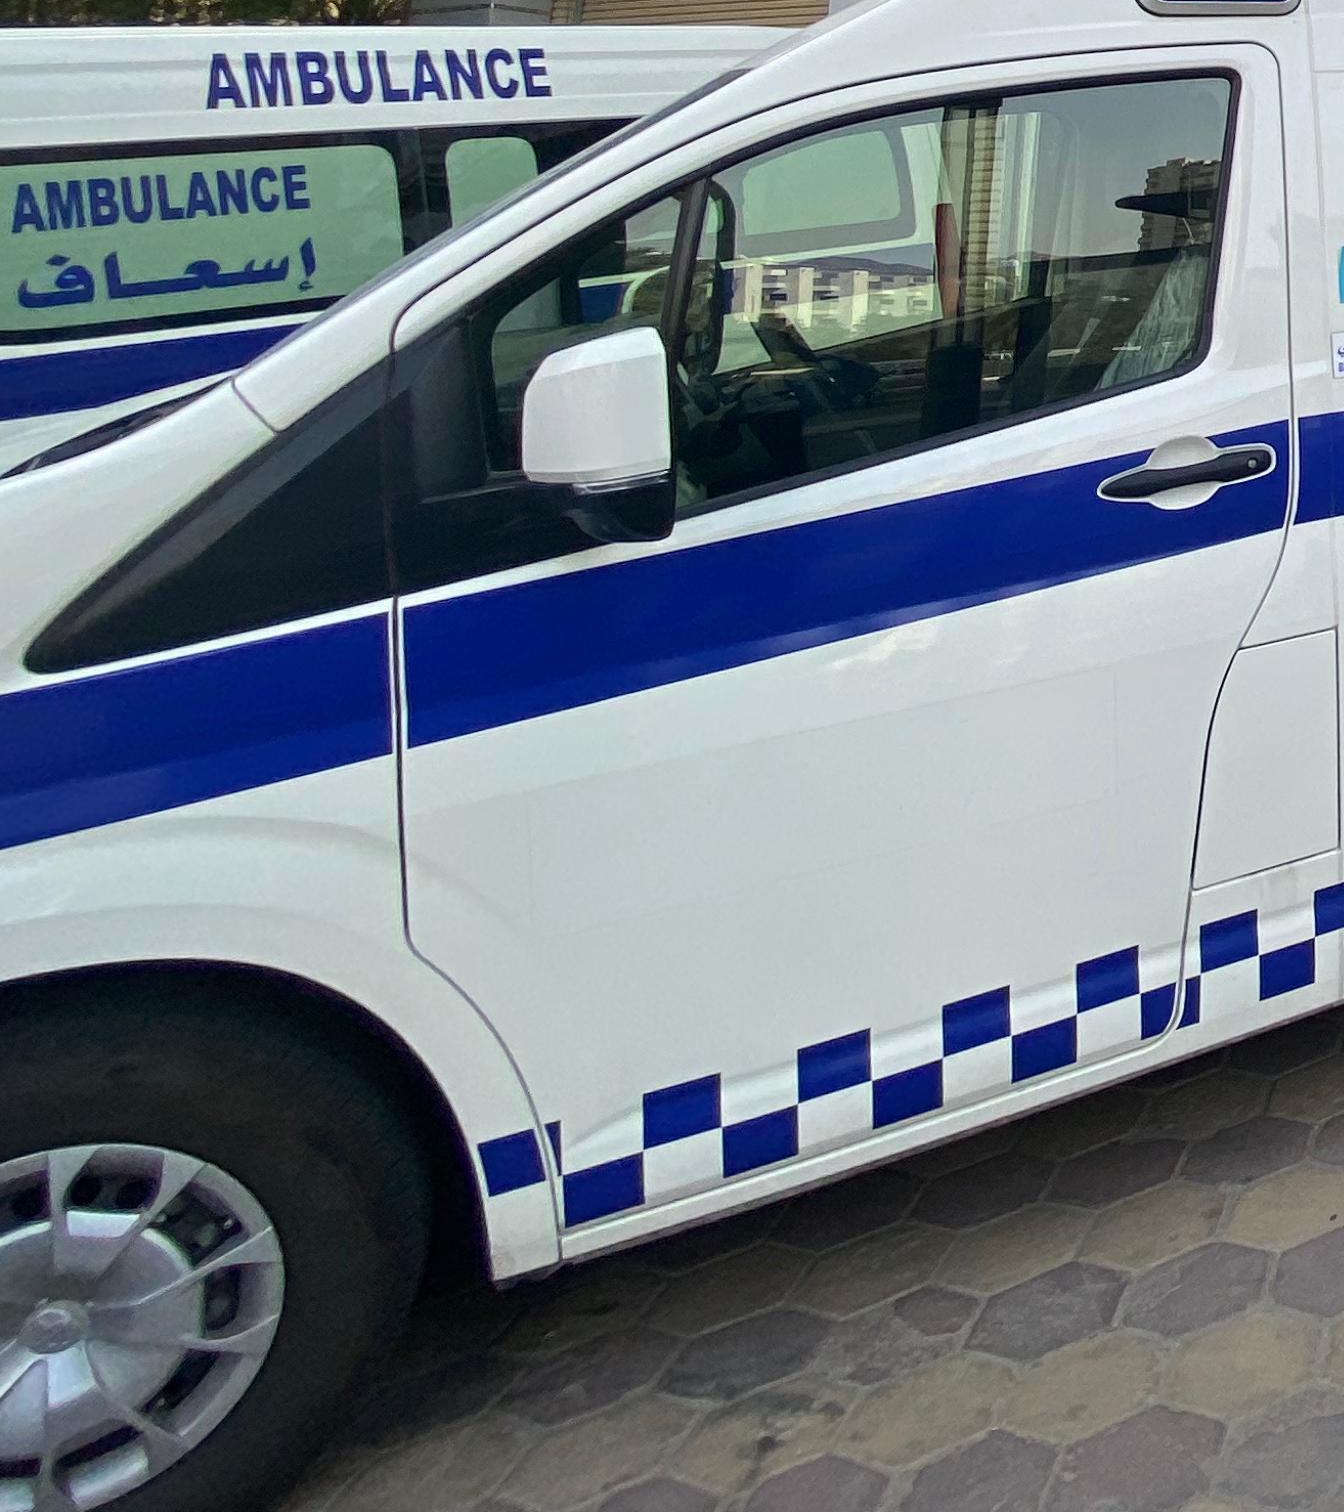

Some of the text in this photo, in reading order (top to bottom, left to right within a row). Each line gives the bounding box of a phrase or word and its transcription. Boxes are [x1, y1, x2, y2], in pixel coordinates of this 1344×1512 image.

[206, 48, 552, 109] AMBULANCE
[11, 164, 312, 233] AMBULANCE
[17, 237, 317, 308] إسعاف
